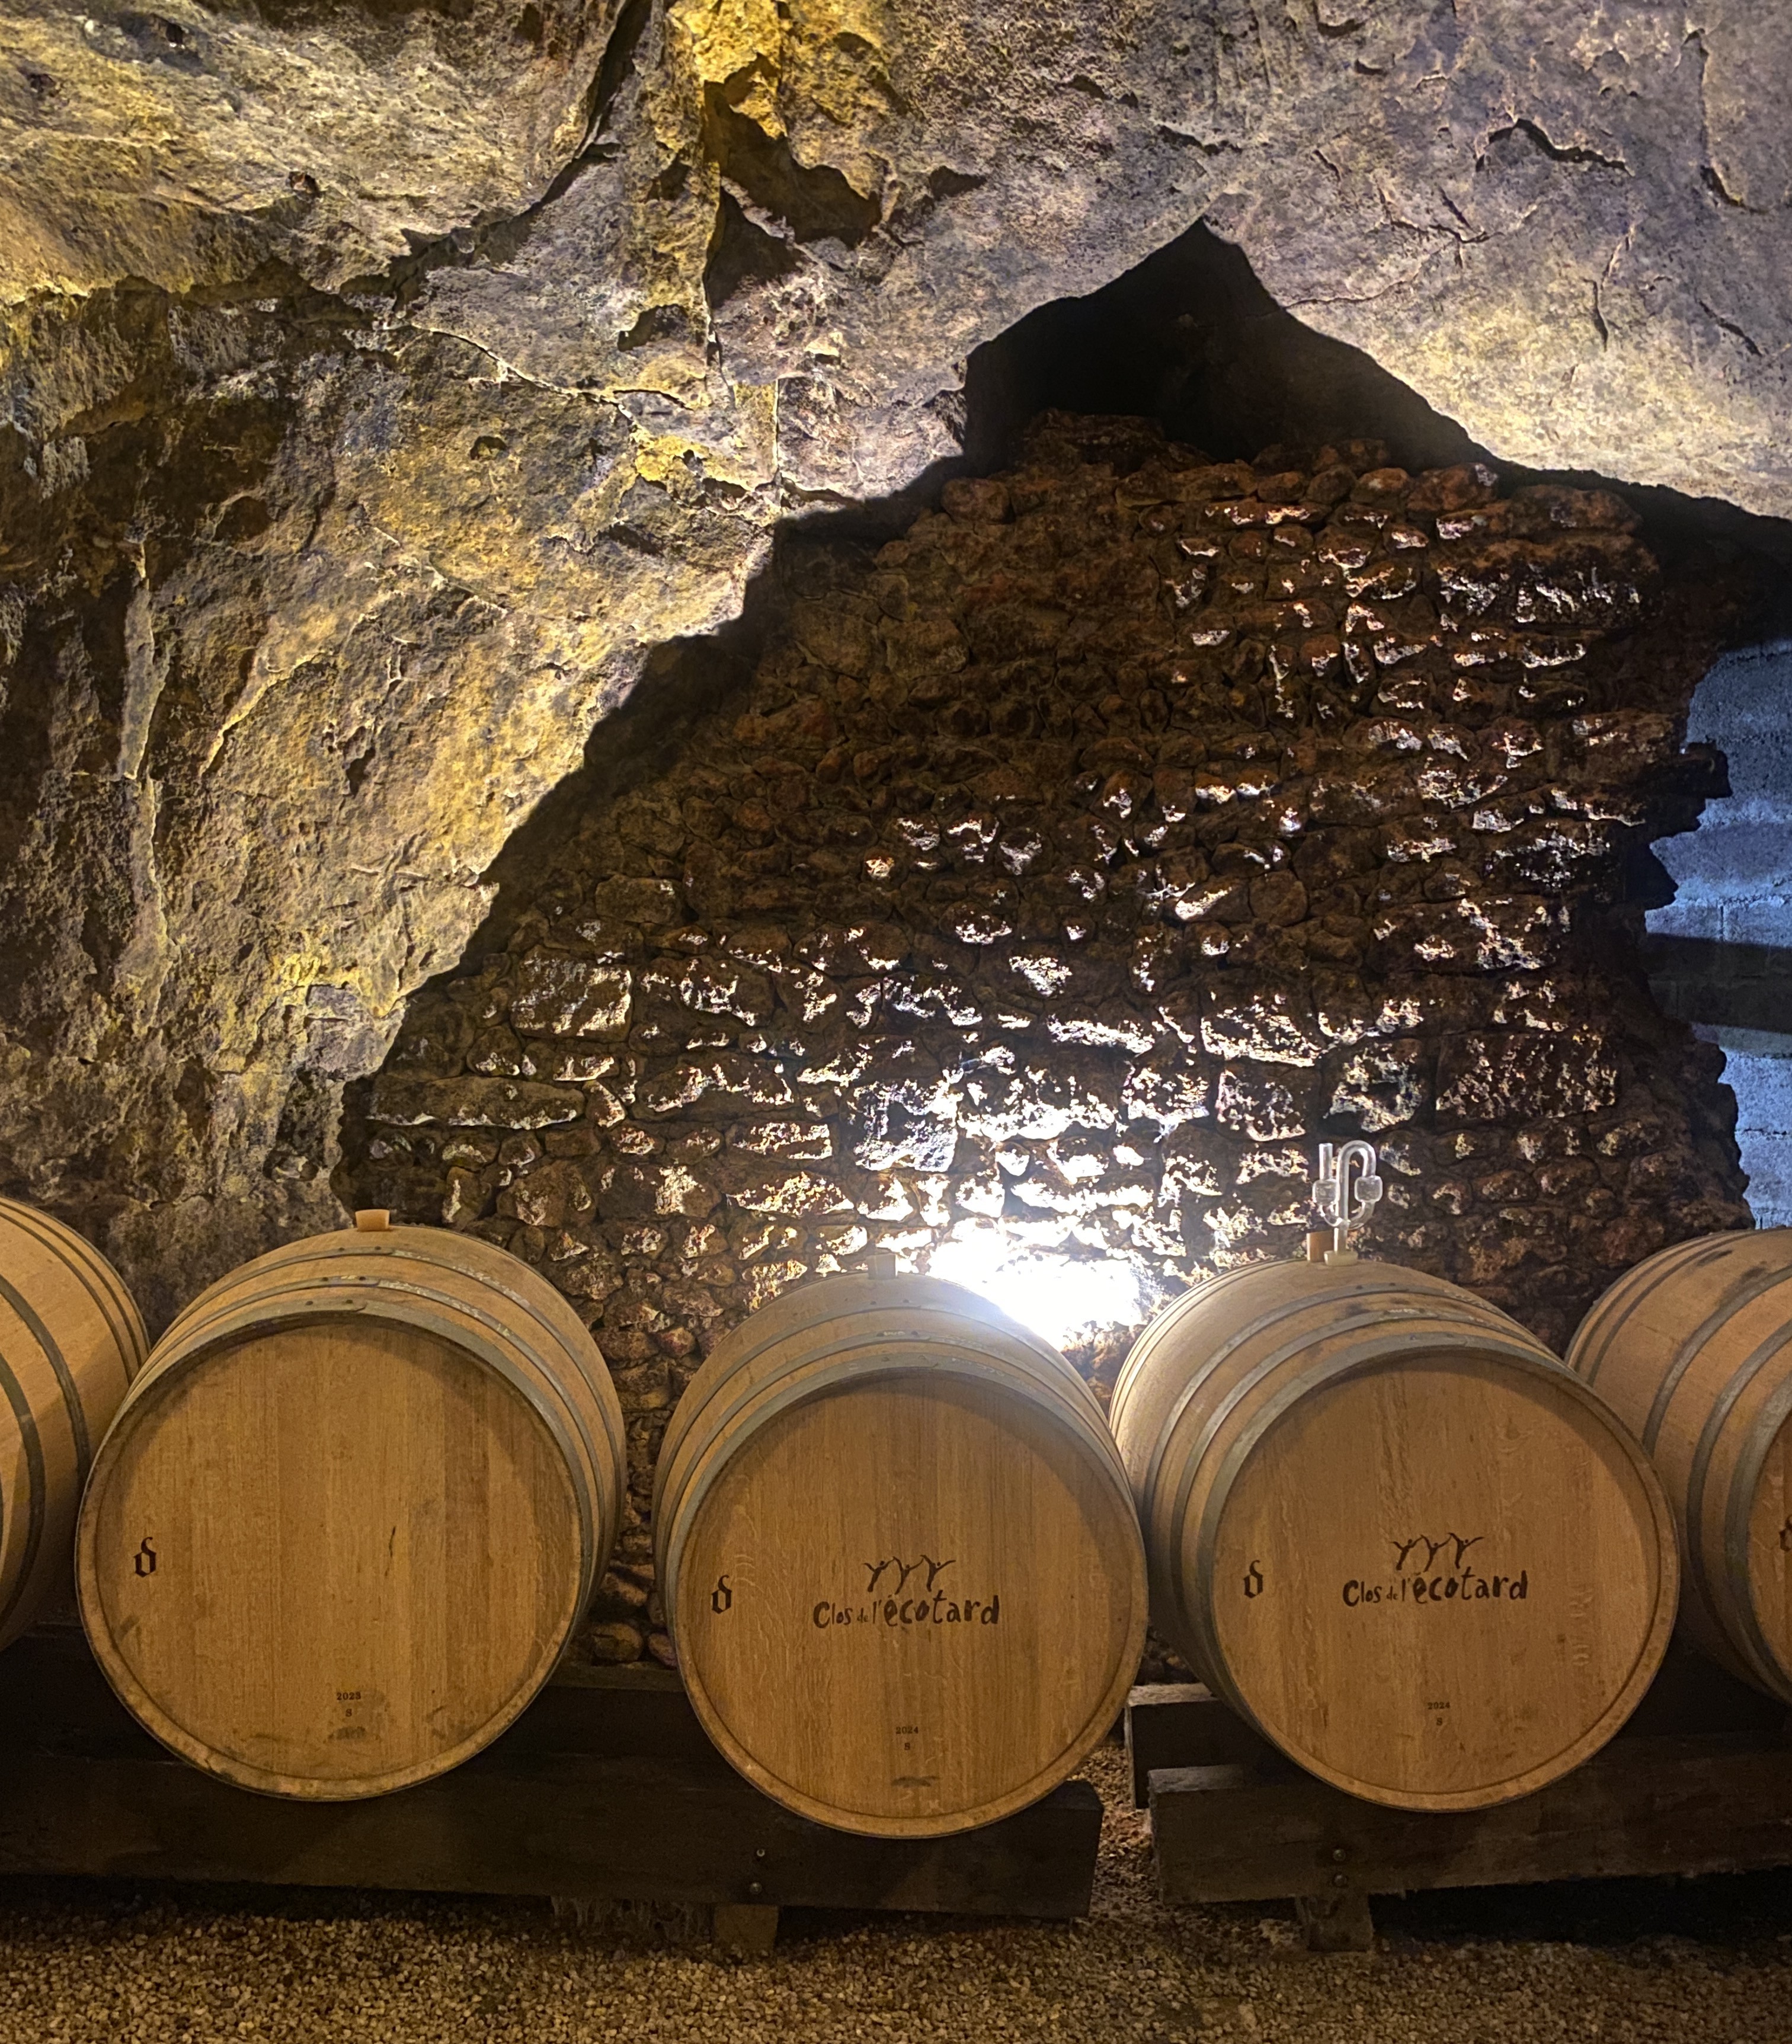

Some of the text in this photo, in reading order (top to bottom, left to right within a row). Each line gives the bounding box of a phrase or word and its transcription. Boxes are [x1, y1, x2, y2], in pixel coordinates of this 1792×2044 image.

[1342, 1579, 1381, 1607] Clos
[1386, 1585, 1399, 1601] de
[813, 1601, 853, 1629] Clos
[857, 1608, 869, 1623] de
[336, 1691, 361, 1701] 2023
[1427, 1701, 1451, 1710] 2024
[895, 1726, 919, 1735] 2024
